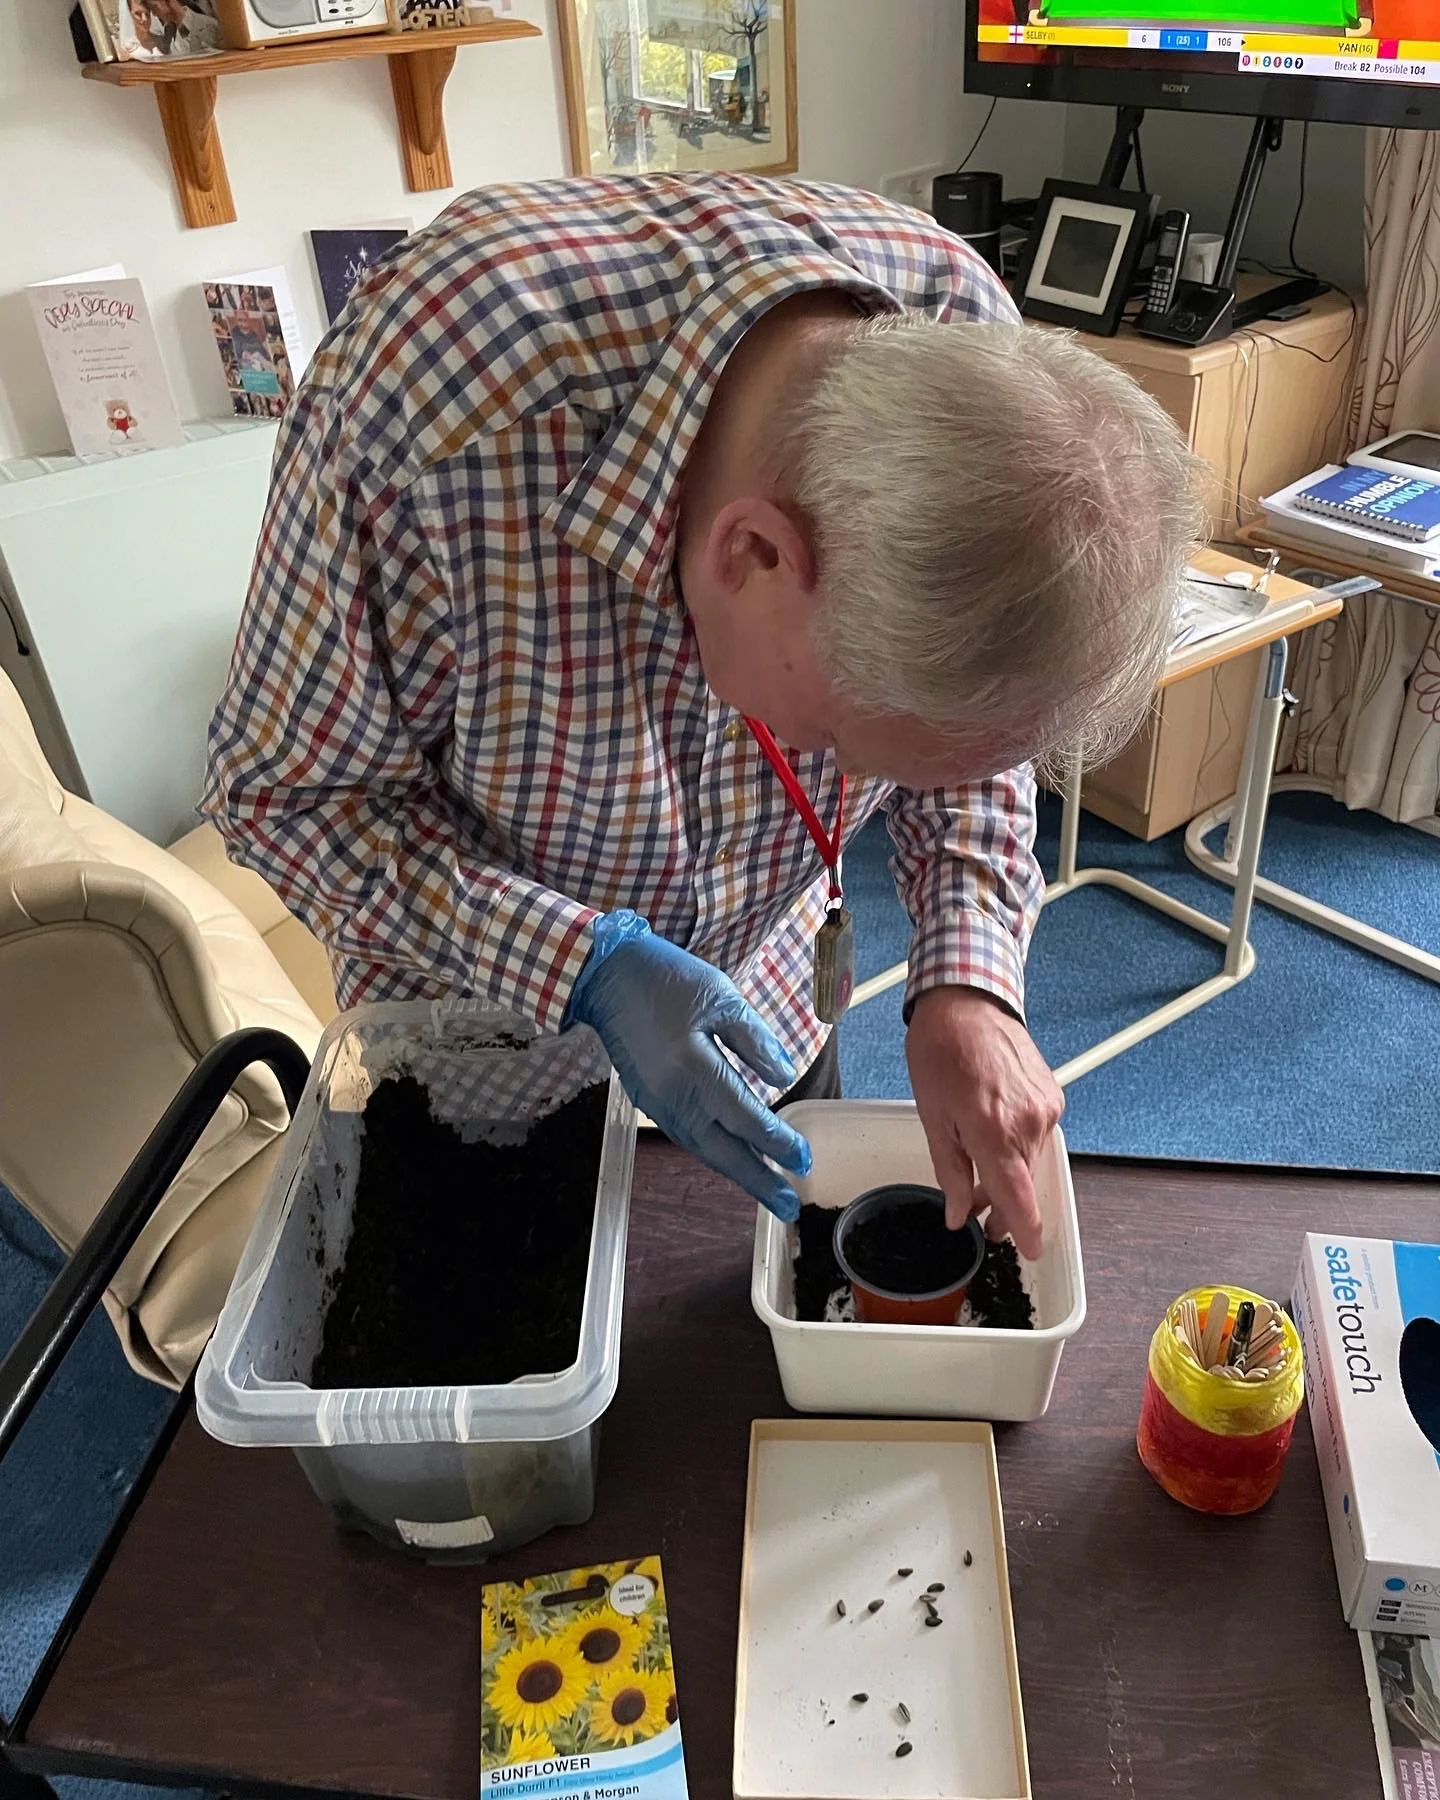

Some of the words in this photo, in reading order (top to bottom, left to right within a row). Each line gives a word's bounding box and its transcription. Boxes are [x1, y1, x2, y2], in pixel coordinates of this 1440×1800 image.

[408, 9, 471, 29] OFTEN
[1026, 31, 1047, 40] SELBY
[1142, 35, 1146, 43] 6
[1176, 36, 1190, 46] (25)
[1218, 37, 1232, 47] 106
[1338, 43, 1358, 53] YAN
[1359, 44, 1373, 54] (16)
[1334, 61, 1357, 72] Break
[1360, 63, 1370, 72] 82
[1374, 63, 1408, 75] Possible
[1410, 66, 1426, 75] 104
[1162, 83, 1190, 94] SONY
[81, 296, 139, 324] SPECIAL
[1344, 475, 1412, 508] HUMBLE
[1370, 481, 1435, 513] OPINION
[1325, 1245, 1382, 1394] safetouch
[491, 1757, 590, 1784] SUNFLOWER
[490, 1785, 514, 1799] Little
[595, 1785, 639, 1800] Morgan
